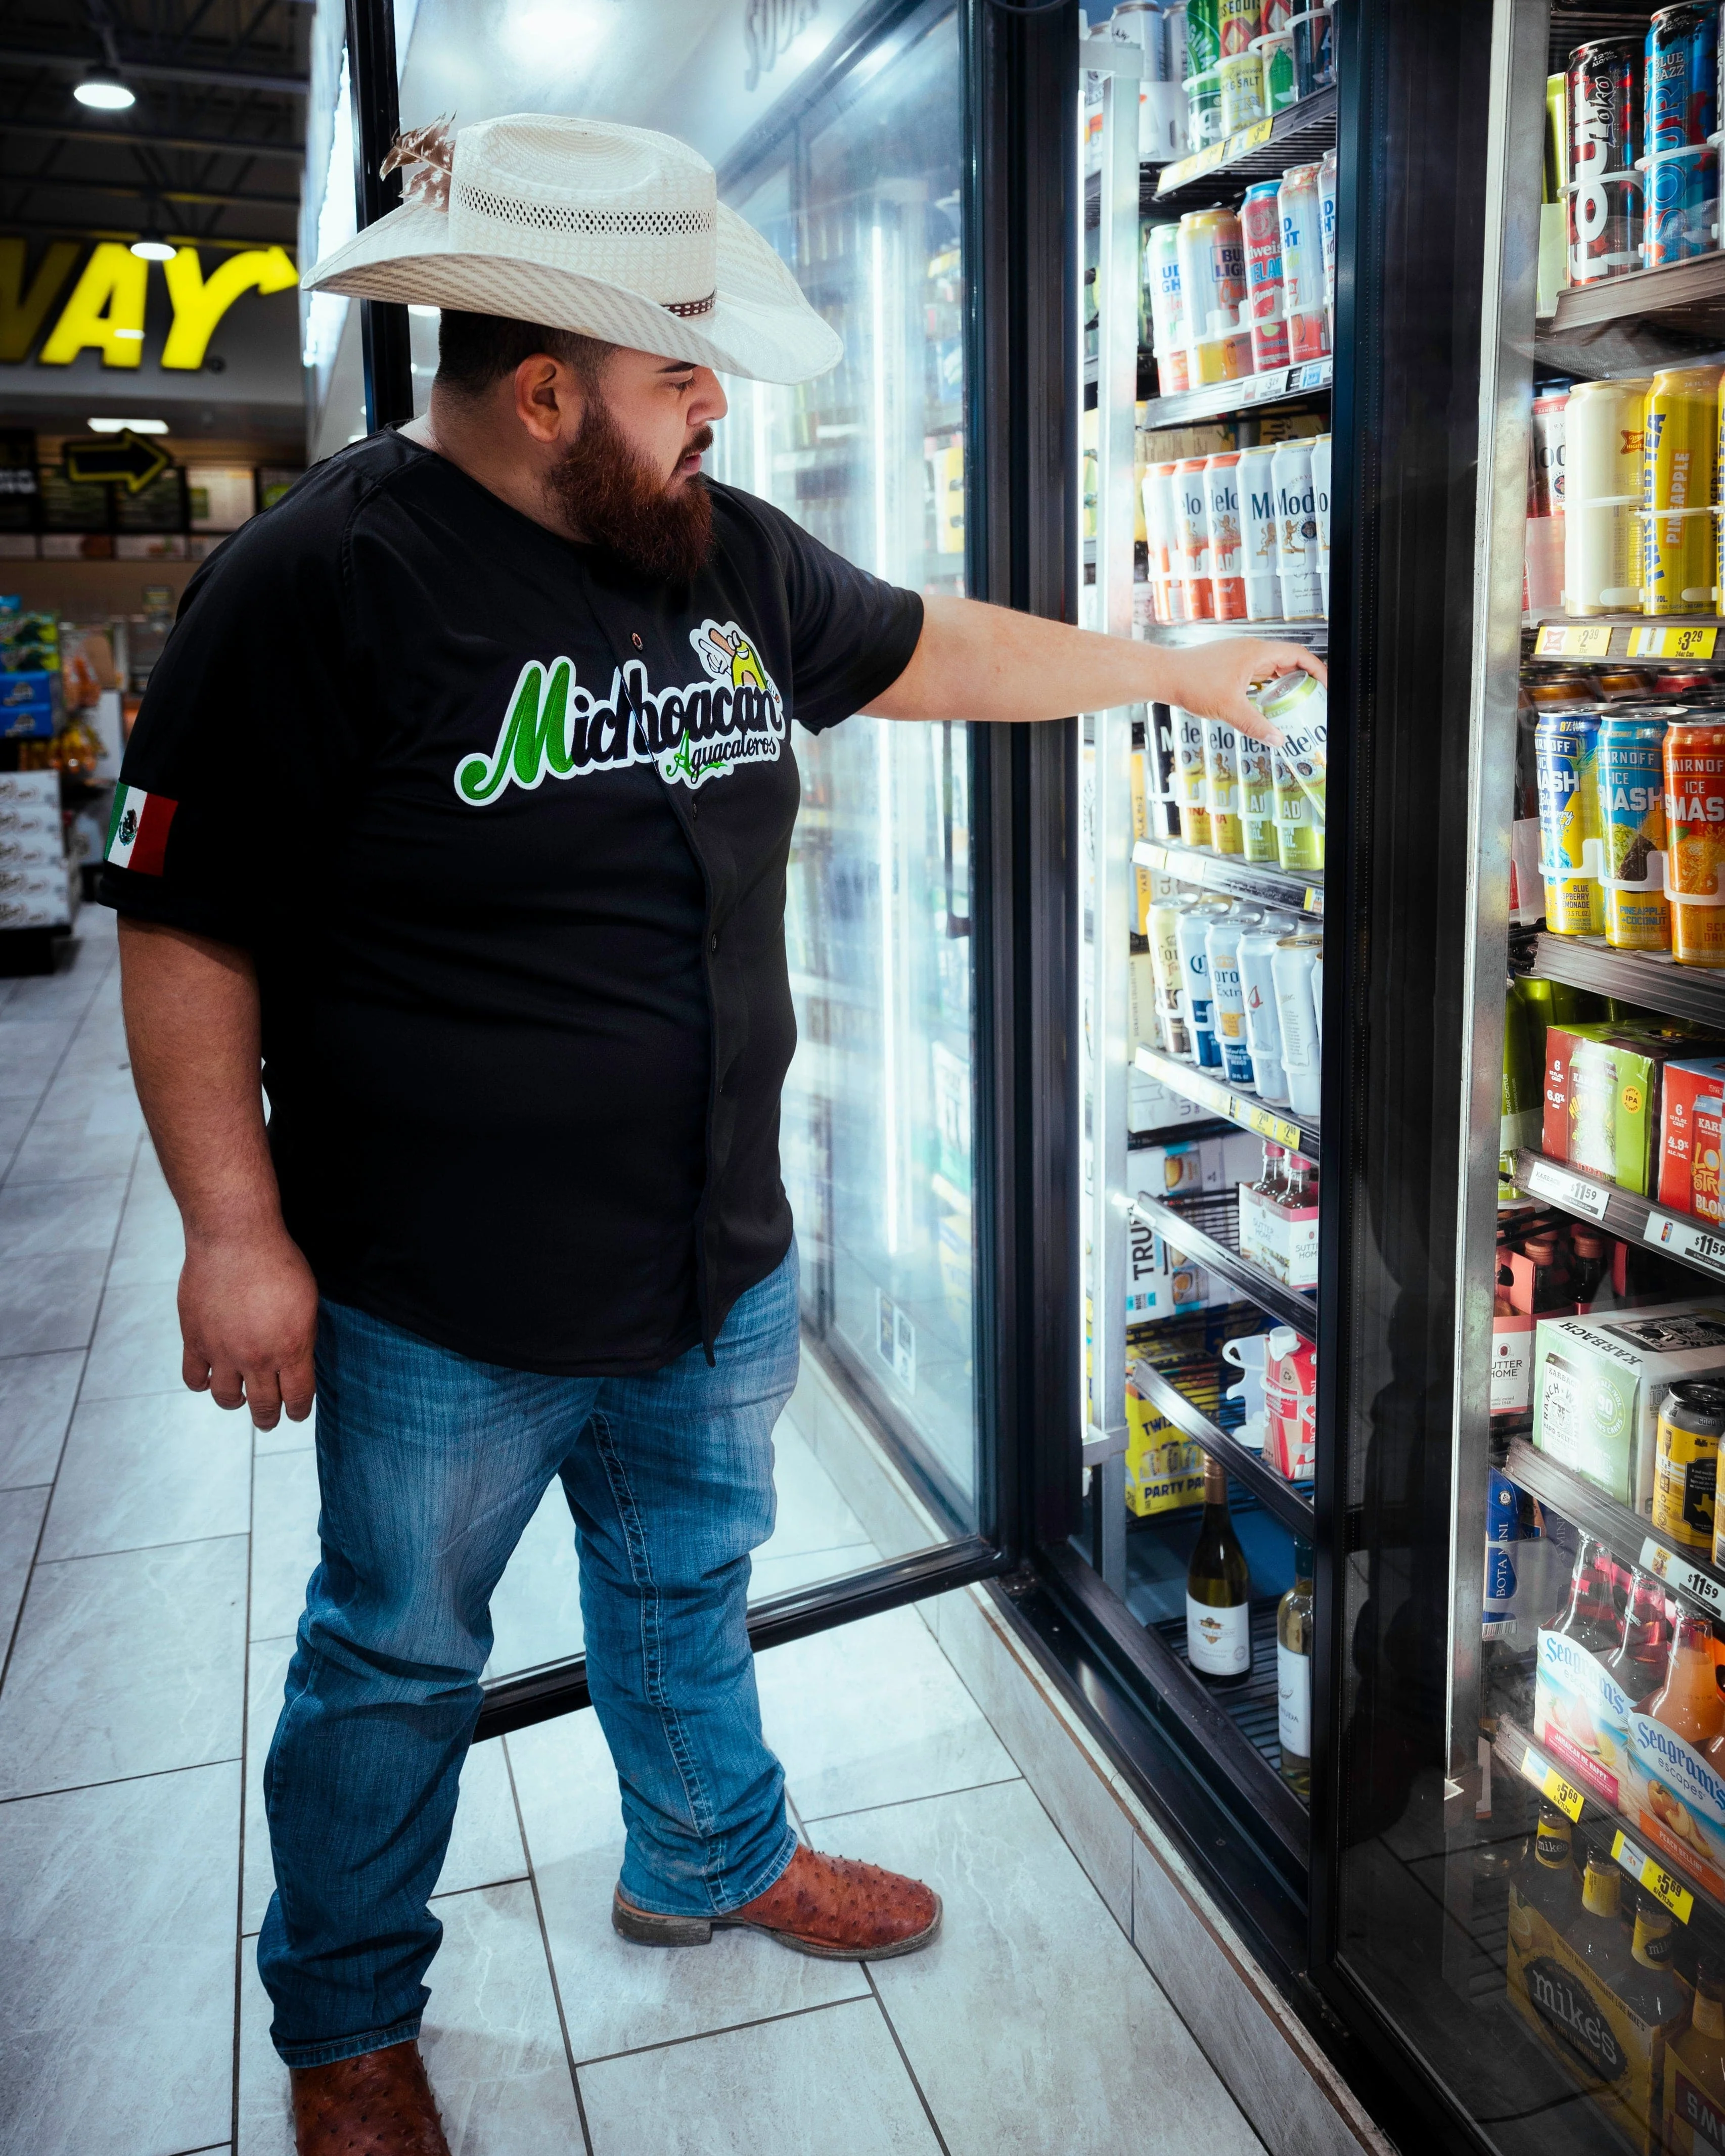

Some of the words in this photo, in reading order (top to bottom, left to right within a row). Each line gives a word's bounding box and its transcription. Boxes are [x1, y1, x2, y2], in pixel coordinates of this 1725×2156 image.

[1655, 52, 1684, 67] BLUE
[1654, 65, 1685, 82] RAZZ
[1588, 76, 1615, 148] Loko
[1645, 414, 1667, 463] TEA
[457, 657, 786, 804] Michoacan
[665, 729, 777, 785] Aguacateros
[1685, 781, 1706, 794] ICE
[1619, 905, 1667, 915] PINEAPPLE
[1554, 1060, 1561, 1072] 6
[1503, 1073, 1511, 1099] CACTUS
[1625, 1094, 1638, 1105] IPA
[1675, 1104, 1683, 1116] 6
[1672, 1120, 1685, 1129] CANS
[1667, 1136, 1689, 1151] 4.9%
[1535, 1171, 1561, 1186] KARBACH
[1559, 1321, 1644, 1365] KARBACH
[1144, 1479, 1185, 1500] PARTY
[1496, 1558, 1508, 1598] BOTA
[1688, 1573, 1719, 1599] $1159
[1545, 1636, 1625, 1715] Seagram's
[1564, 1668, 1604, 1708] escapes
[1555, 1733, 1581, 1759] JAMAICAN
[1581, 1755, 1589, 1766] ME
[1589, 1761, 1608, 1781] HAPPY
[1637, 1721, 1725, 1811] Seagram's
[1658, 1757, 1703, 1801] escapes
[1557, 1782, 1578, 1804] $569
[1537, 1839, 1568, 1854] mike's
[1659, 1830, 1678, 1853] PEACH
[1678, 1847, 1703, 1873] BELLINI
[1657, 1872, 1683, 1898] $569
[1532, 1969, 1617, 2065] mike's
[1615, 1997, 1628, 2014] LIKE
[1627, 2009, 1646, 2032] MIKE'S
